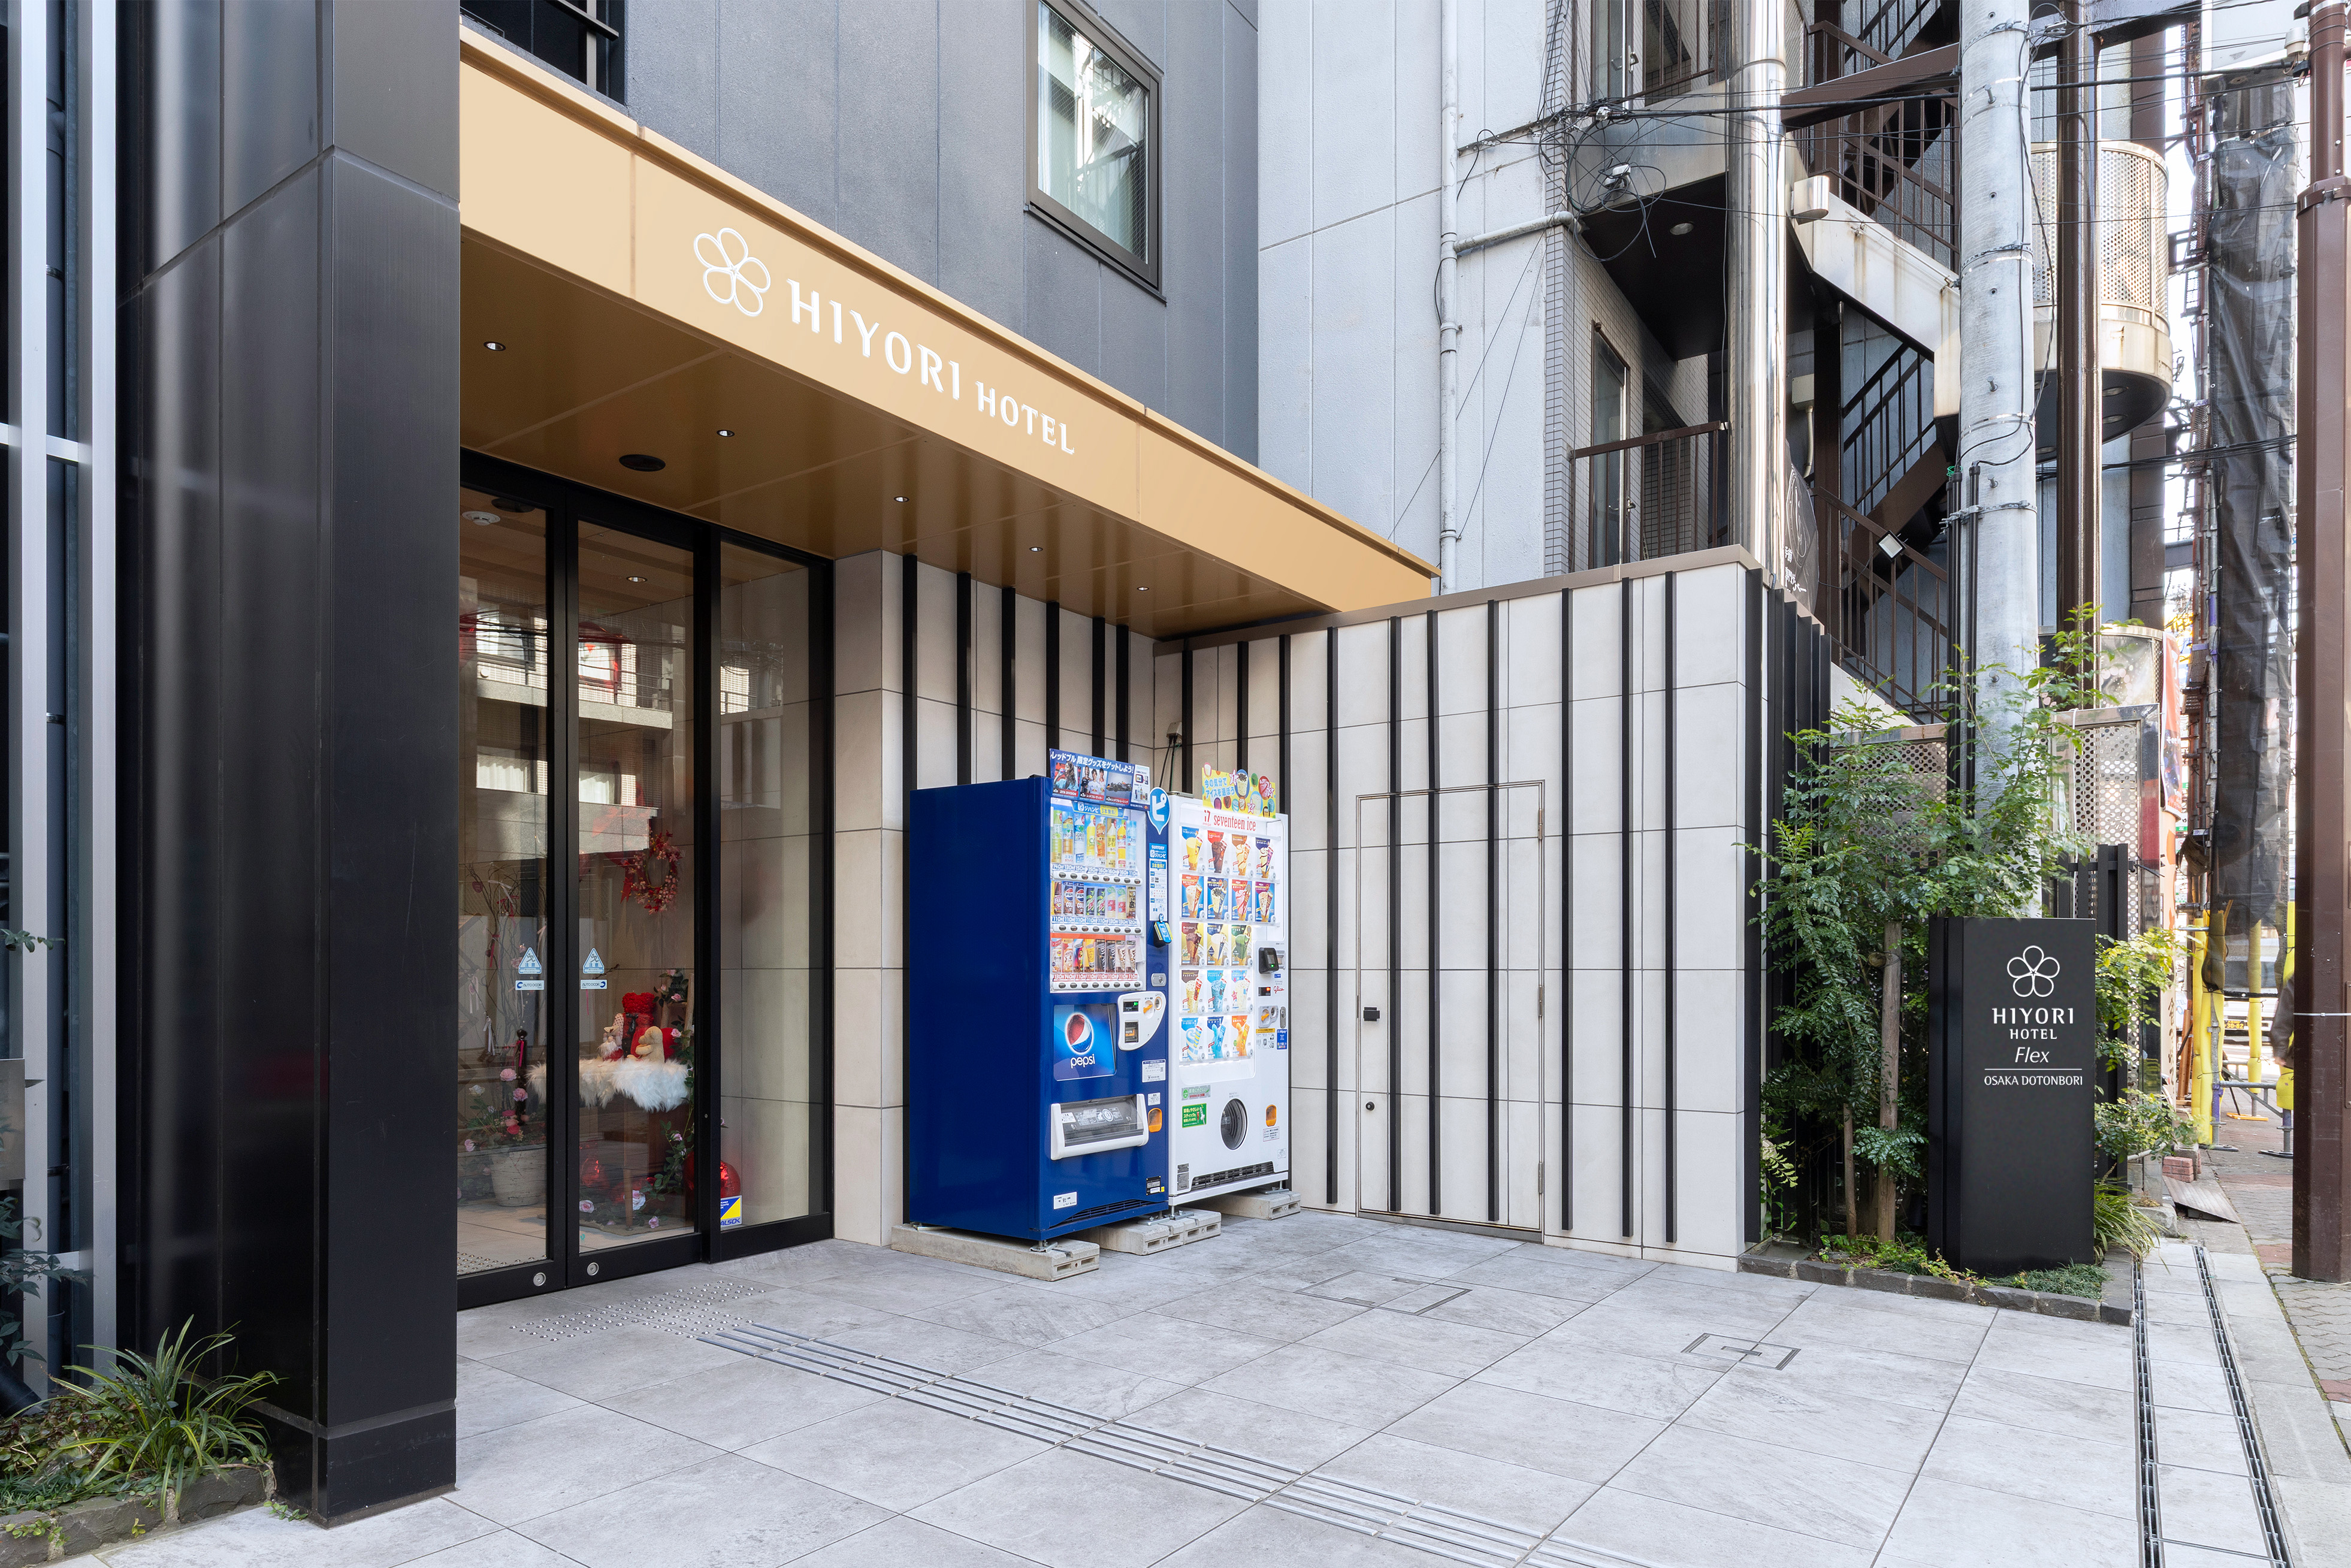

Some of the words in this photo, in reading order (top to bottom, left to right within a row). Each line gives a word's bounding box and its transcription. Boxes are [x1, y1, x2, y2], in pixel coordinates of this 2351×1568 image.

[786, 278, 961, 400] HIYORI
[976, 380, 1075, 454] HOTEL
[1051, 751, 1077, 763] レッドブル
[1204, 778, 1227, 788] 今の気分で
[1205, 787, 1235, 799] アイスを選ぼう
[1152, 793, 1167, 821] ピ
[1213, 815, 1245, 830] seventeen
[1247, 817, 1256, 831] ice
[1992, 1008, 2074, 1024] HIYORI
[2009, 1029, 2057, 1040] HOTEL
[1071, 1053, 1095, 1068] pepsi
[2015, 1047, 2050, 1063] Flex
[1984, 1075, 2019, 1086] OSAKA
[2021, 1075, 2083, 1086] DOTONBORI
